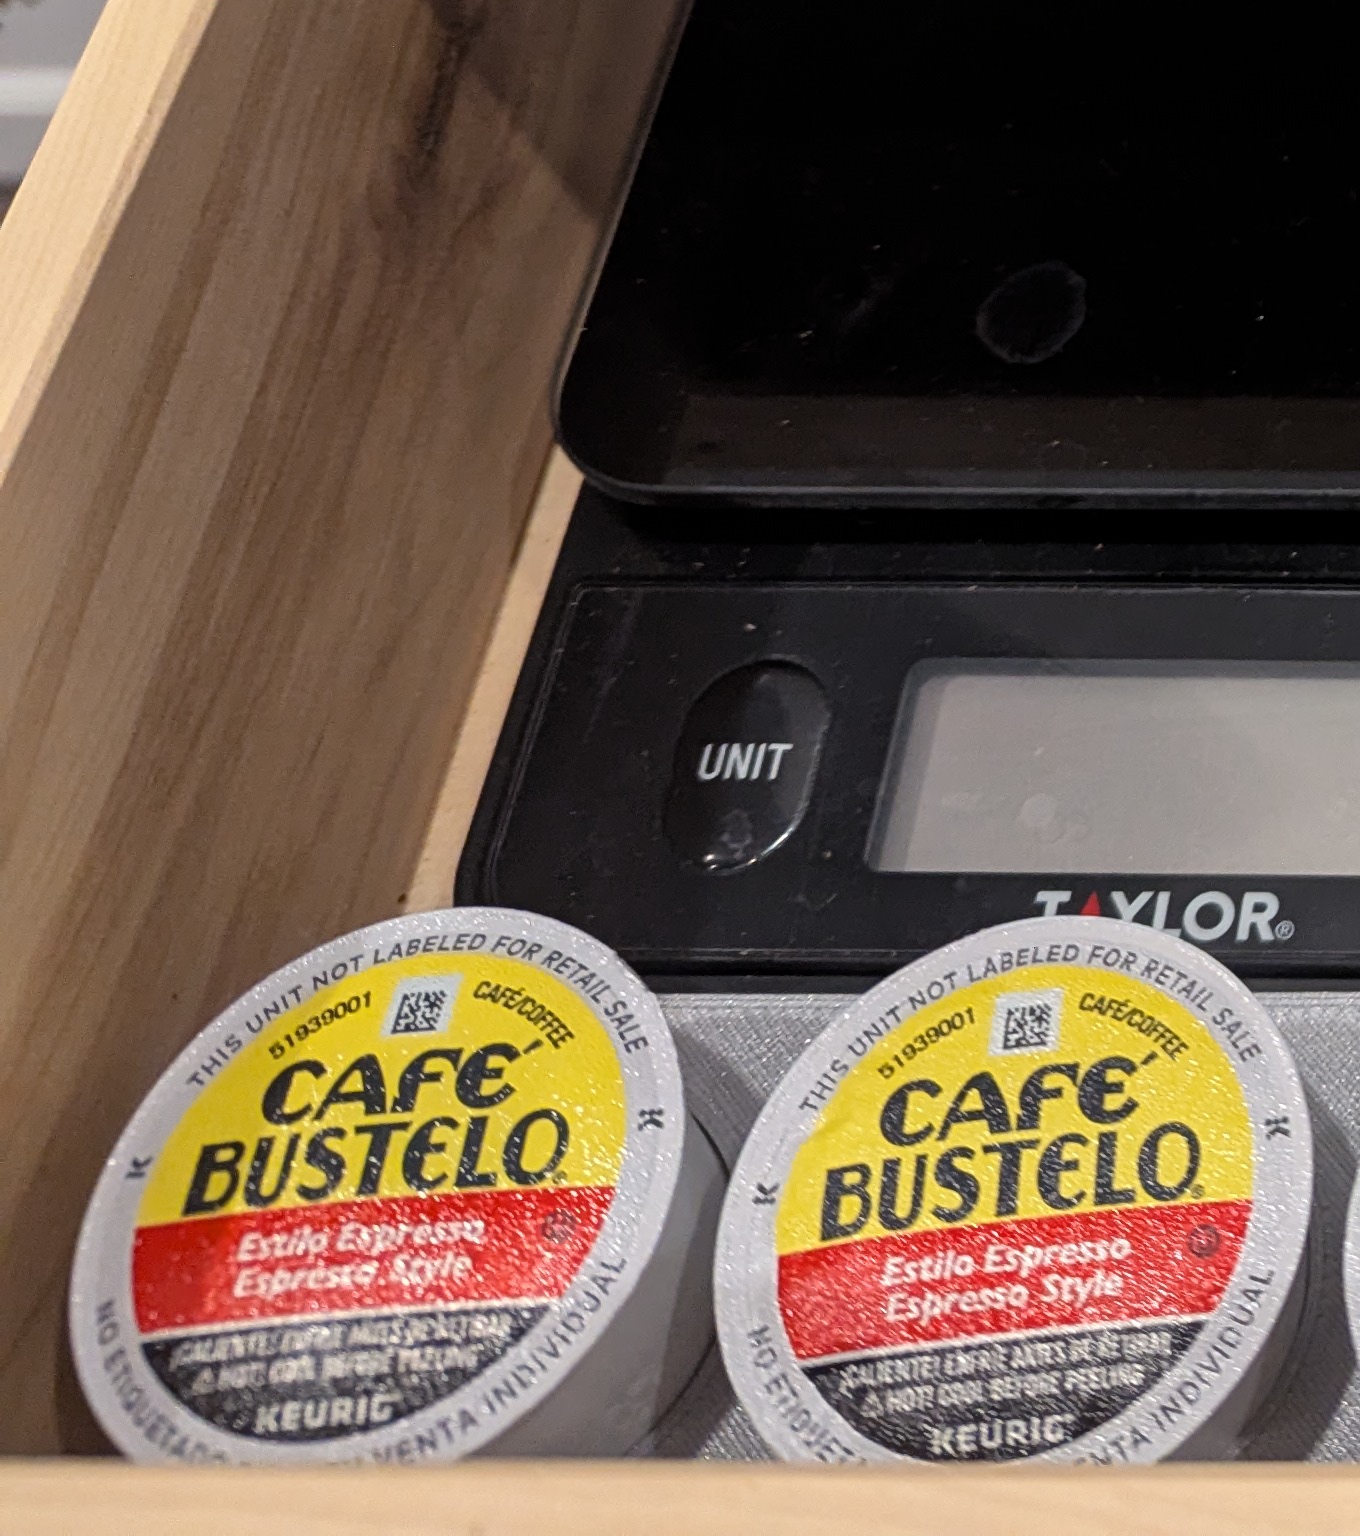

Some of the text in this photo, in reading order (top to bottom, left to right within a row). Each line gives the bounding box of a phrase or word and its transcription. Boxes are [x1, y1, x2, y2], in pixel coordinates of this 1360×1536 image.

[697, 743, 793, 781] UNIT
[187, 933, 650, 1089] THIS UNIT NOT LABELED FOR RETAIL SALE
[182, 1108, 571, 1216] BUSTELO
[820, 1121, 1200, 1242] BUSTELO
[236, 1219, 486, 1262] Estilo Espresso
[882, 1237, 1131, 1288] Estilo Espresso
[232, 1252, 473, 1298] Espresso Style
[886, 1271, 1124, 1327] Espresso Style
[255, 1397, 401, 1434] KEURIG
[930, 1419, 1063, 1455] KEURIG
